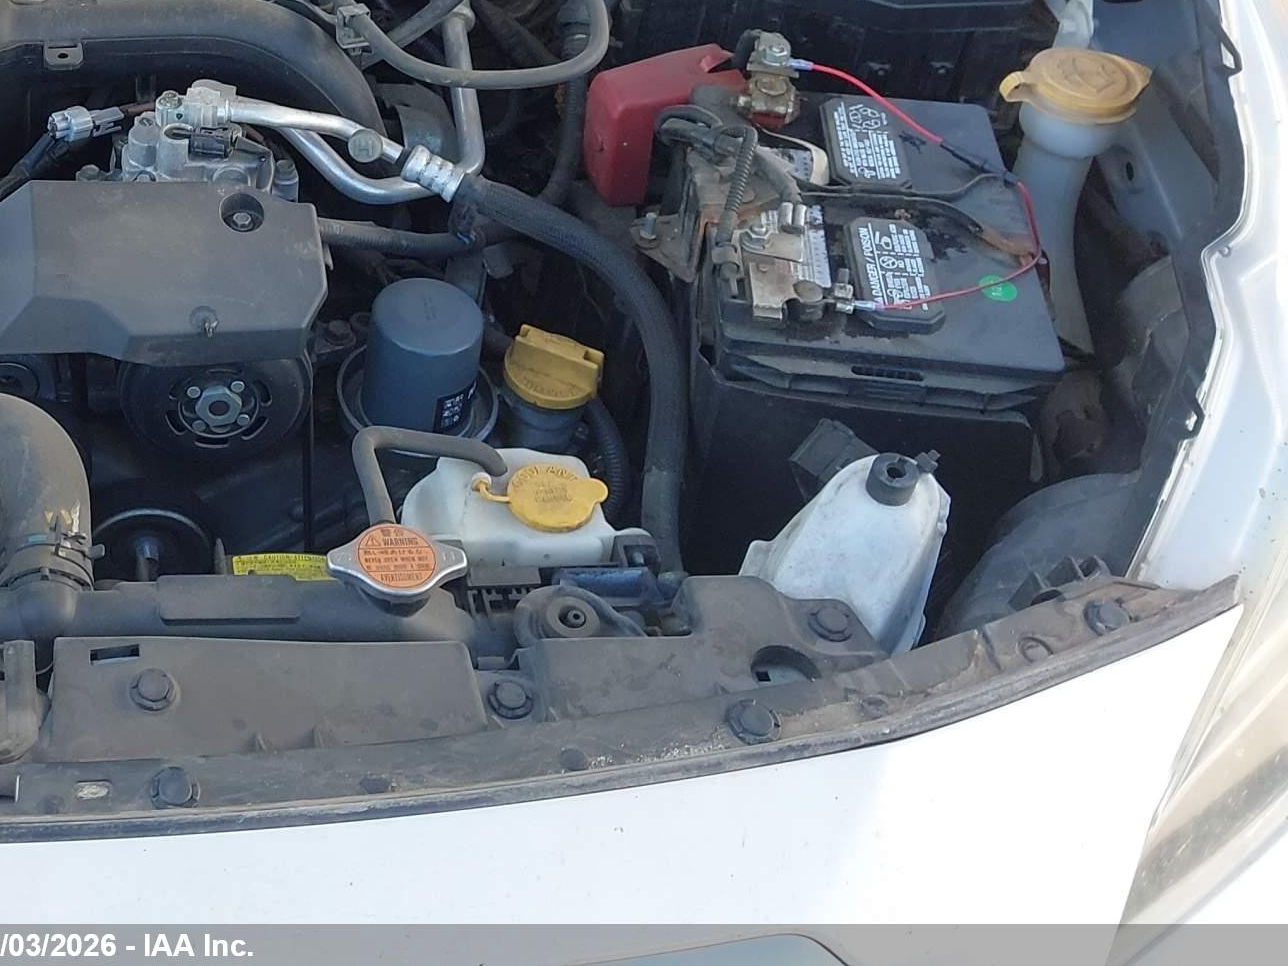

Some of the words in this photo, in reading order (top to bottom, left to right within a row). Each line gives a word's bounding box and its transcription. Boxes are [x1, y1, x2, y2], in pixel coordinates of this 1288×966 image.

[858, 227, 873, 256] POISON
[866, 263, 883, 296] DANGER
[383, 537, 419, 546] WARNING
